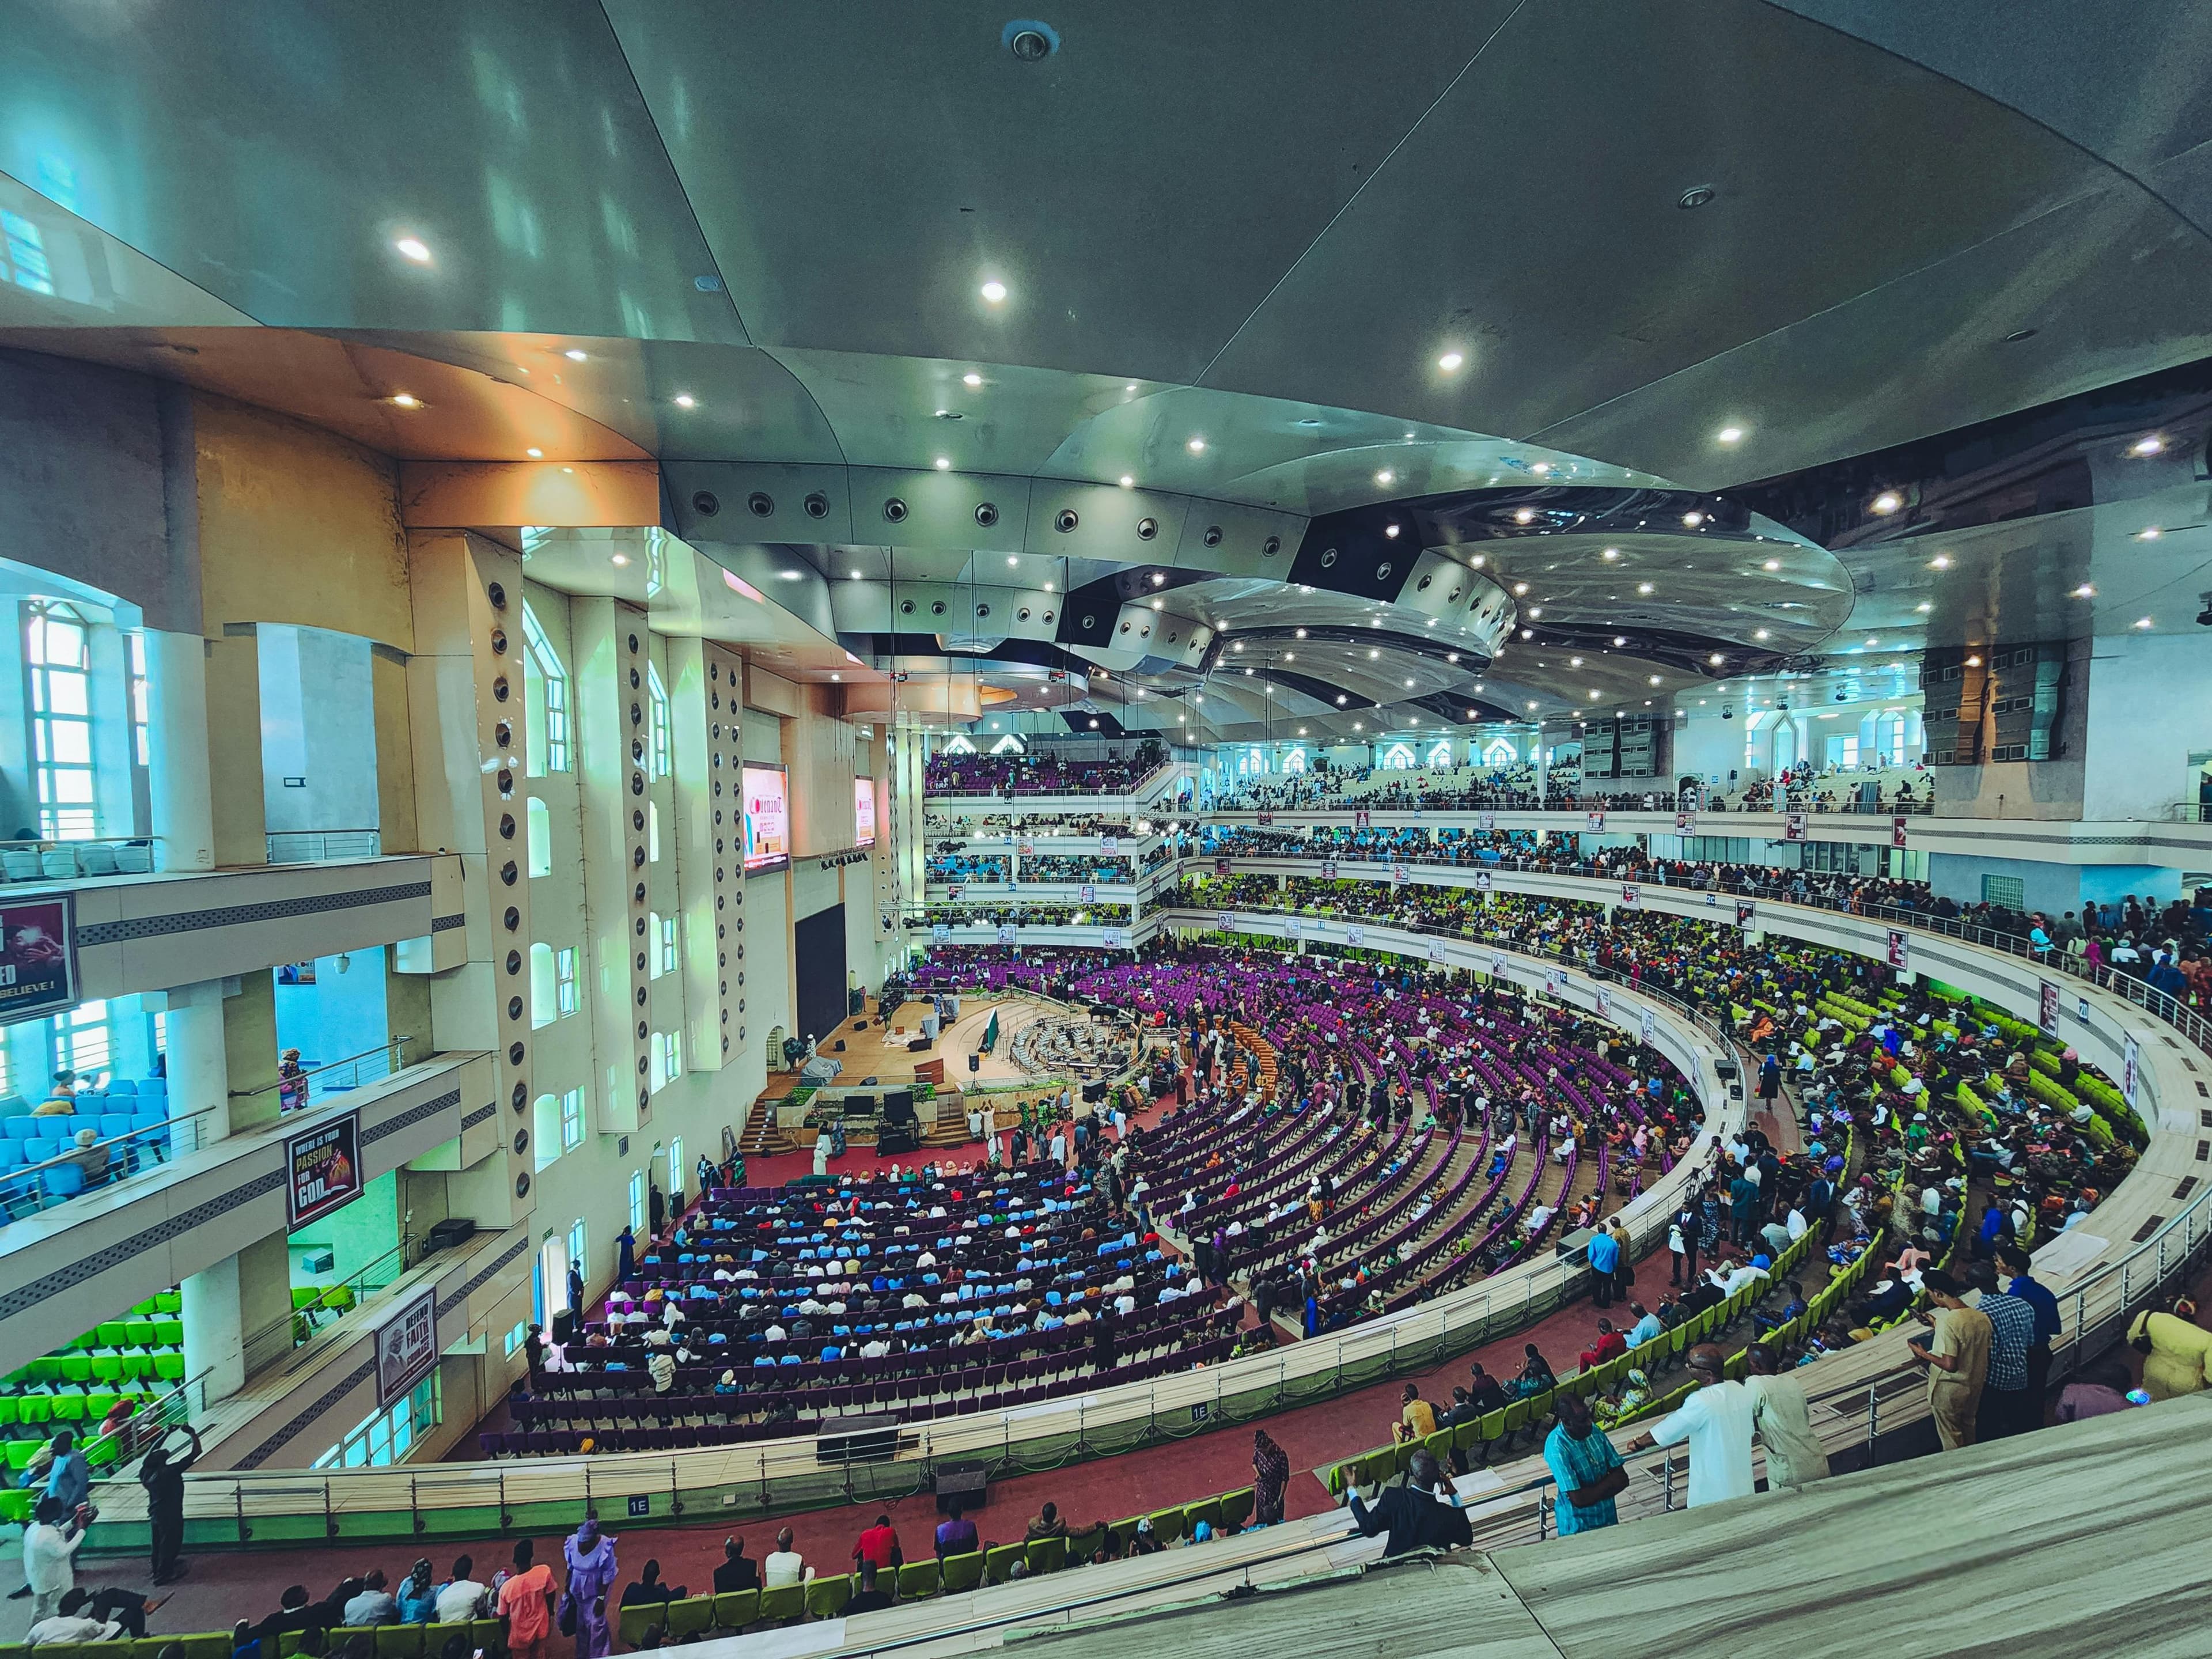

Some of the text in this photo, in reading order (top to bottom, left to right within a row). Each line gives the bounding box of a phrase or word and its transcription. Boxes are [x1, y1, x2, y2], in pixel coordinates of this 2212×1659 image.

[1706, 895, 1714, 904] 2C
[1560, 972, 1566, 981] 1C
[317, 1135, 323, 1147] IS
[296, 1143, 332, 1173] PASSION
[297, 1171, 310, 1185] FOR
[298, 1177, 325, 1208] GOD
[406, 1302, 428, 1331] DEFEND
[406, 1317, 429, 1350] FAITH
[1194, 1407, 1205, 1419] 1E
[631, 1499, 646, 1513] 1E
